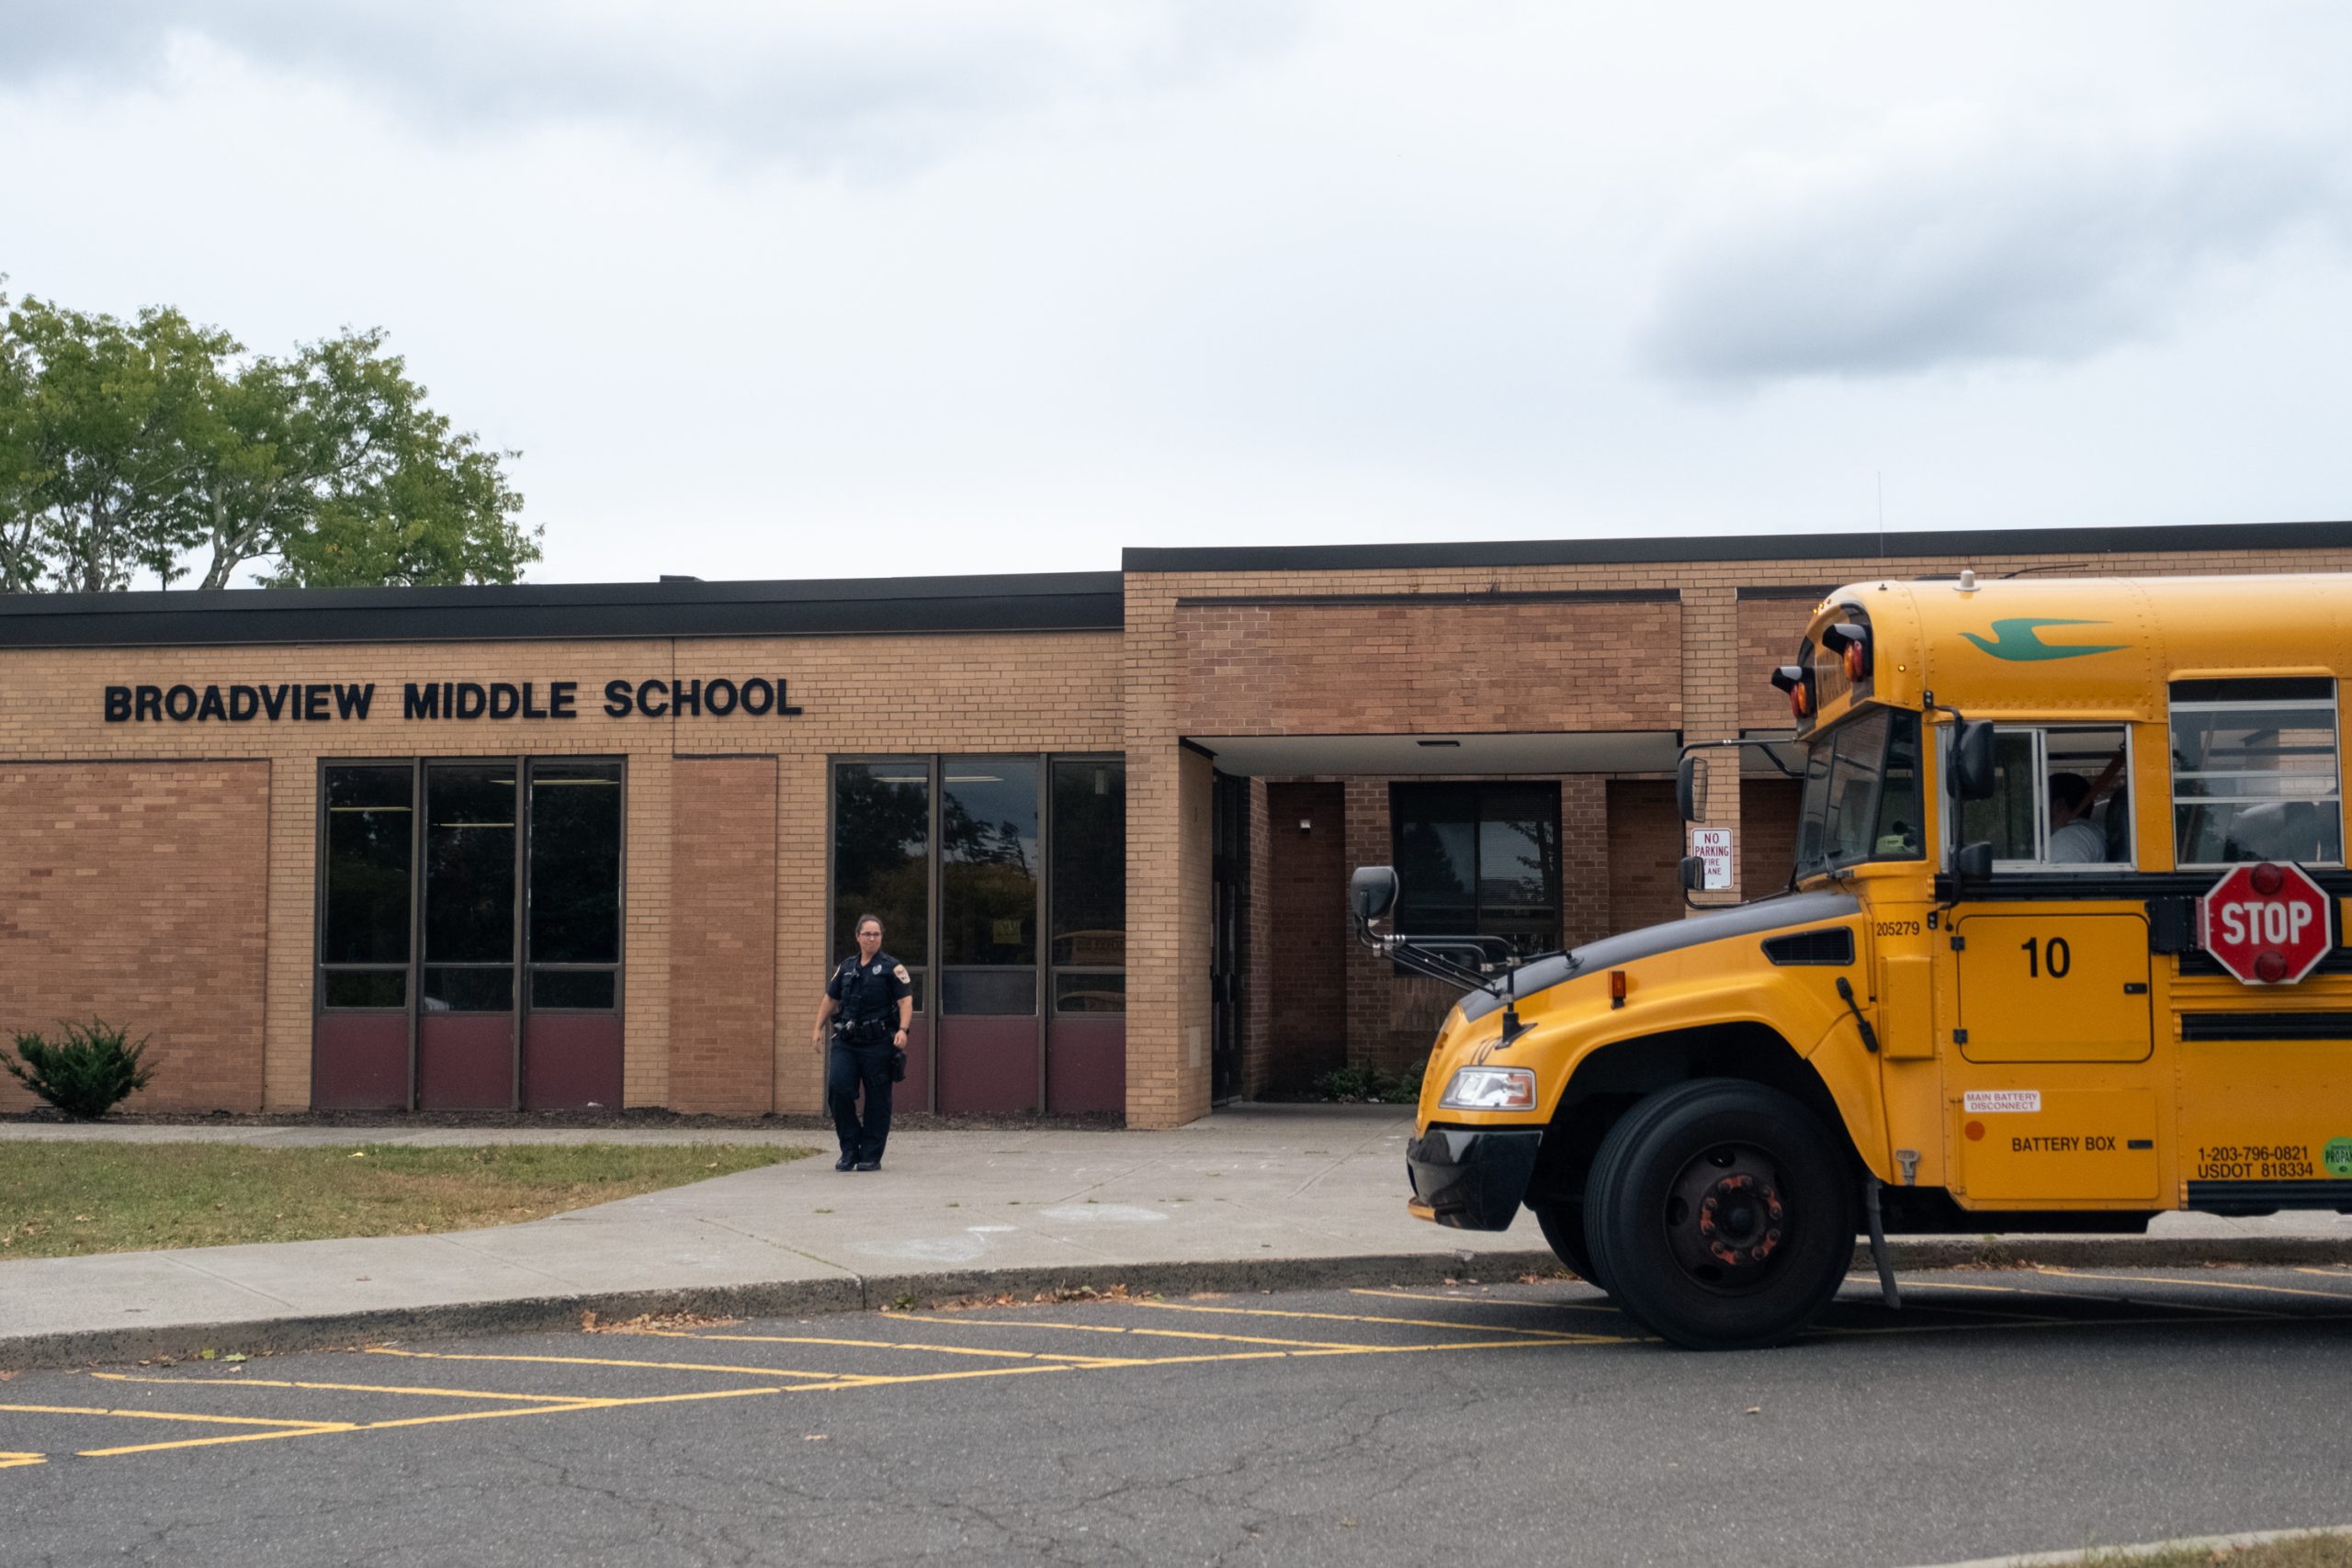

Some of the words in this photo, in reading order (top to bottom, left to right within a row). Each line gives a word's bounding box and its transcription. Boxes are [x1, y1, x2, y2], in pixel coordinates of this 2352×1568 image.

[105, 683, 375, 722] BROADVIEW
[403, 682, 578, 719] MIDDLE
[603, 678, 802, 717] SCHOOL
[1704, 833, 1720, 844] NO
[1695, 846, 1729, 857] PARKING
[1704, 867, 1722, 875] ANE
[1876, 921, 1920, 936] 205279
[2222, 901, 2312, 945] STOP
[2021, 937, 2071, 978] 10
[1966, 1092, 1991, 1101] MAIN
[1994, 1091, 2038, 1101] BATTERY
[1970, 1101, 2034, 1111] DISCONNECT
[2012, 1137, 2079, 1152] BATTERY
[2085, 1136, 2116, 1151] BOX
[2199, 1146, 2308, 1161] 1-203-796-0821
[2198, 1163, 2253, 1179] USDOT
[2261, 1162, 2314, 1177] 818334
